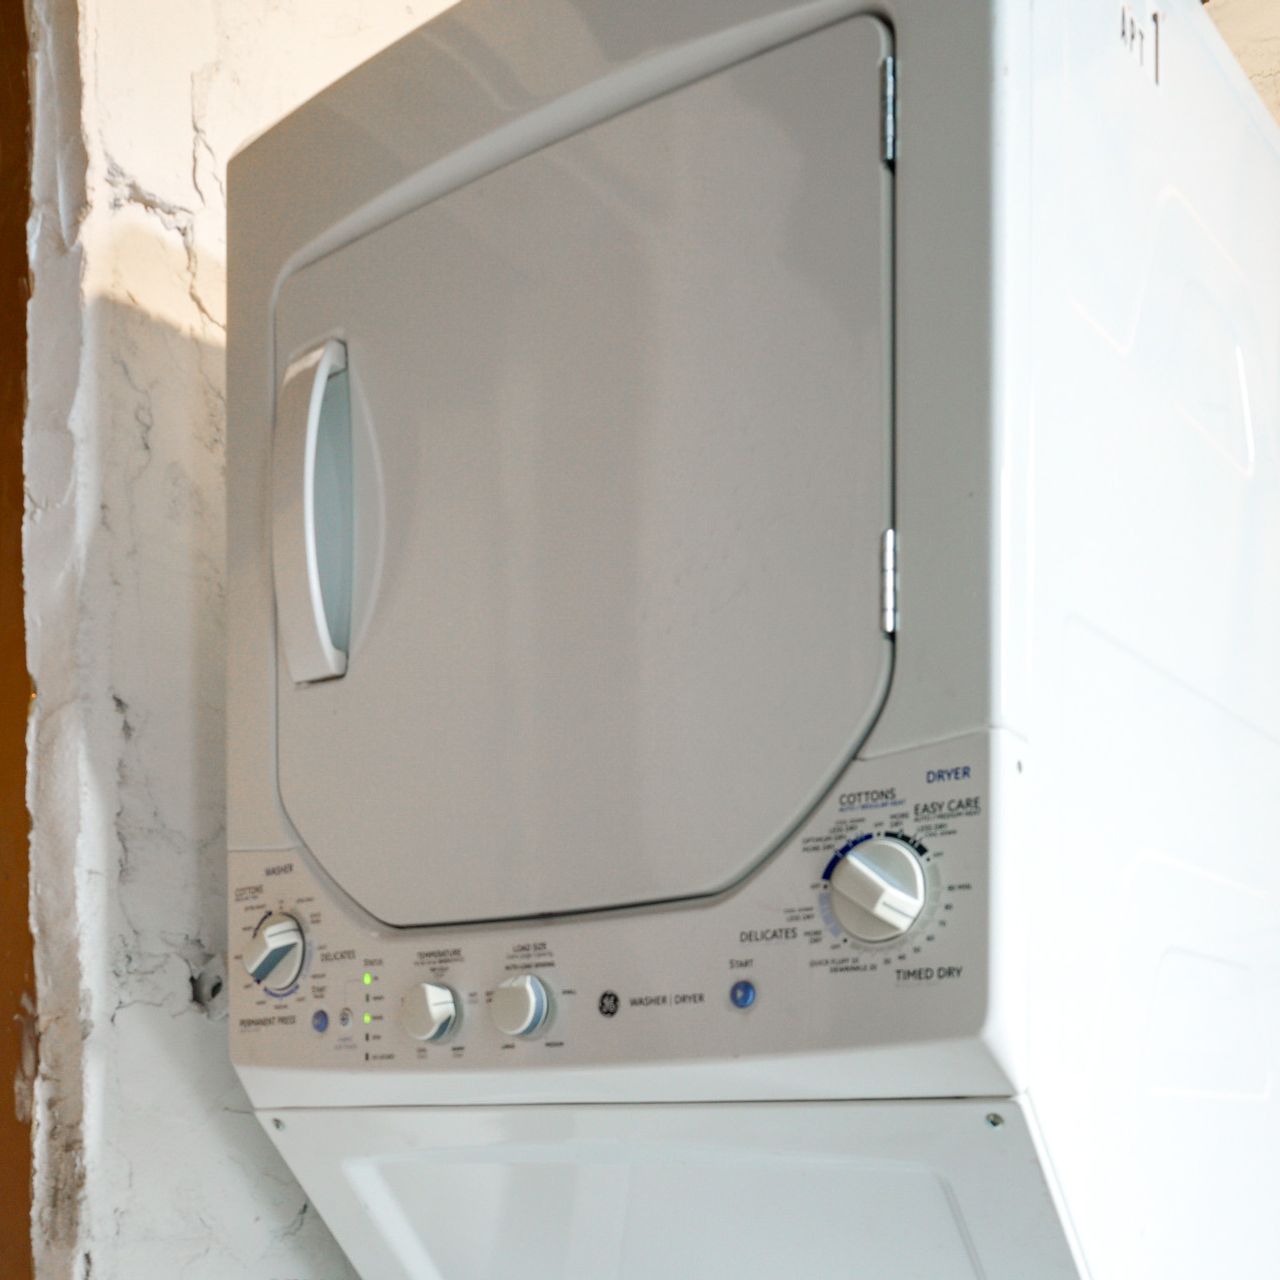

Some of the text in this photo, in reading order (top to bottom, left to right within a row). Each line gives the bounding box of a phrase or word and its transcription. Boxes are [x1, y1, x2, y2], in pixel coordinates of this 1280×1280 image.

[926, 766, 971, 783] DRYER
[839, 788, 896, 805] COTTONS
[913, 797, 980, 817] EASY CARE
[264, 864, 294, 876] WASHER
[739, 927, 798, 943] DELICATES
[728, 958, 755, 970] START
[895, 965, 963, 981] TIMED DRY
[629, 992, 706, 1007] WASHER DRYER
